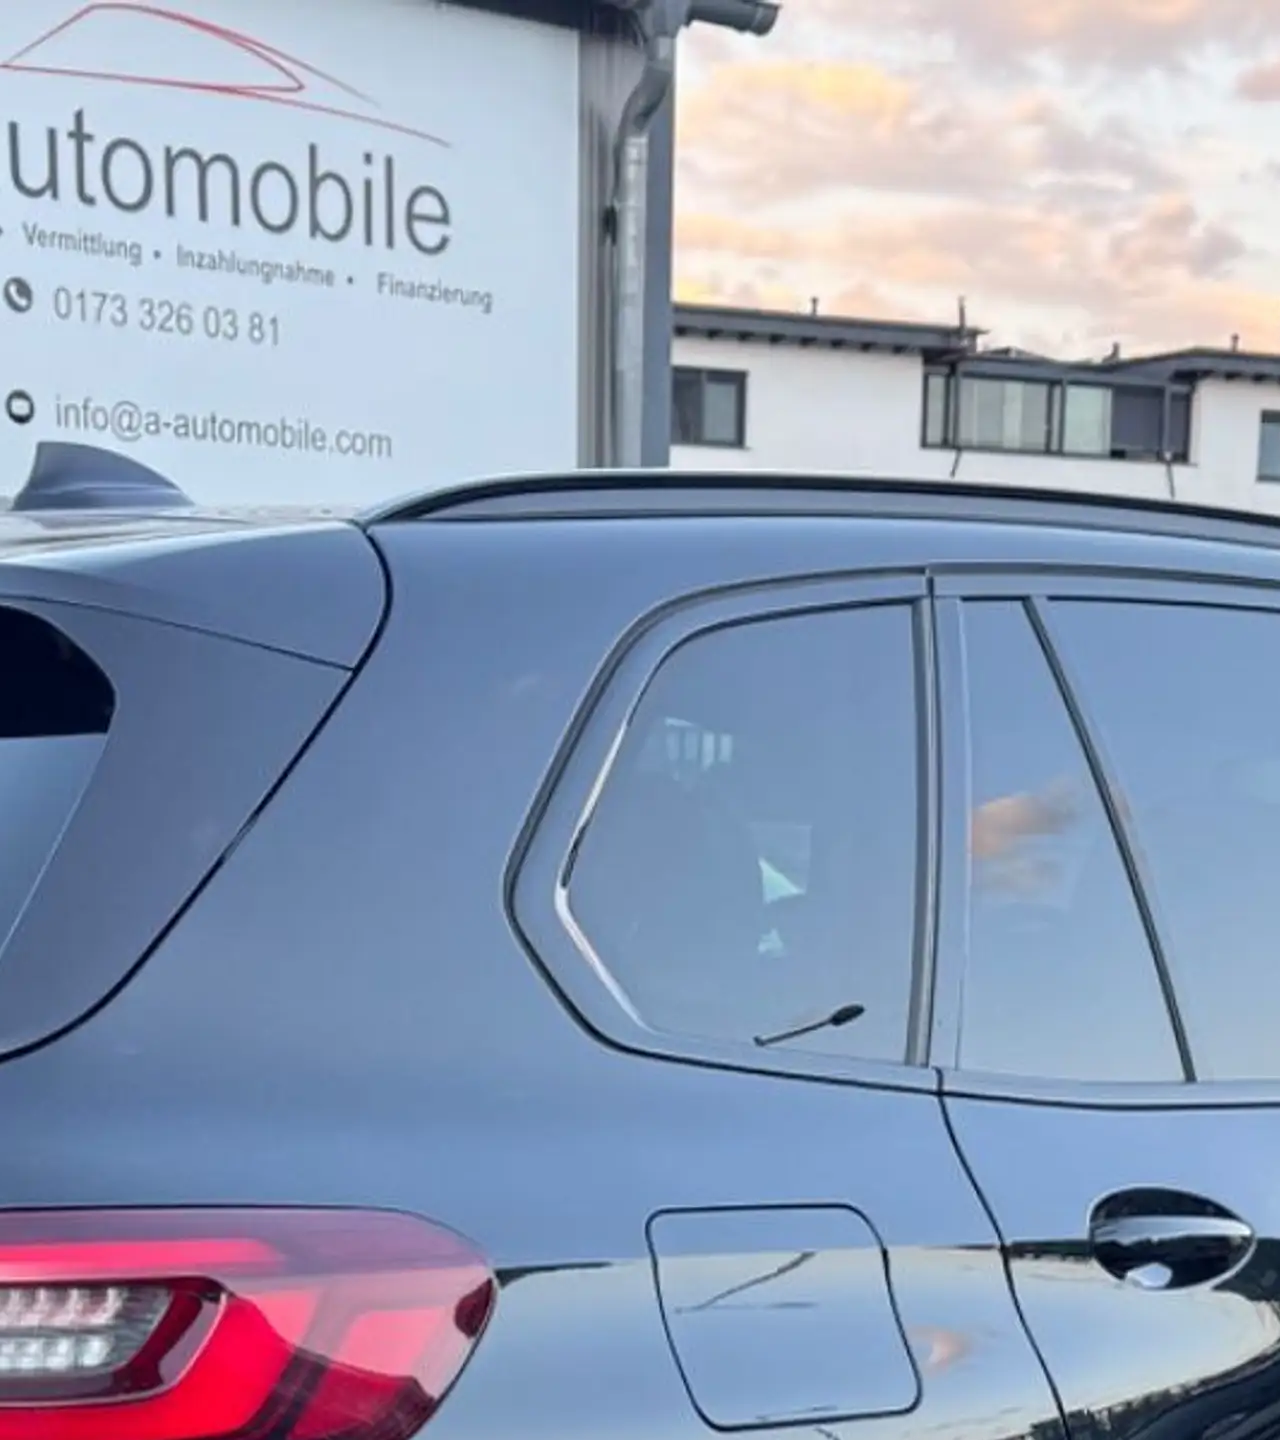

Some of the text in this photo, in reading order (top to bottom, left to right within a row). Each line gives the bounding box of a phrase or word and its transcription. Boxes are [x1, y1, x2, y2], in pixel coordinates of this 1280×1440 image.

[21, 221, 143, 266] Vermittlung
[176, 244, 335, 286] Inzahlungnahme
[376, 271, 494, 314] Finanzierung
[52, 286, 280, 346] 0173 326 03 81
[54, 393, 393, 458] info@a-automobile.com
